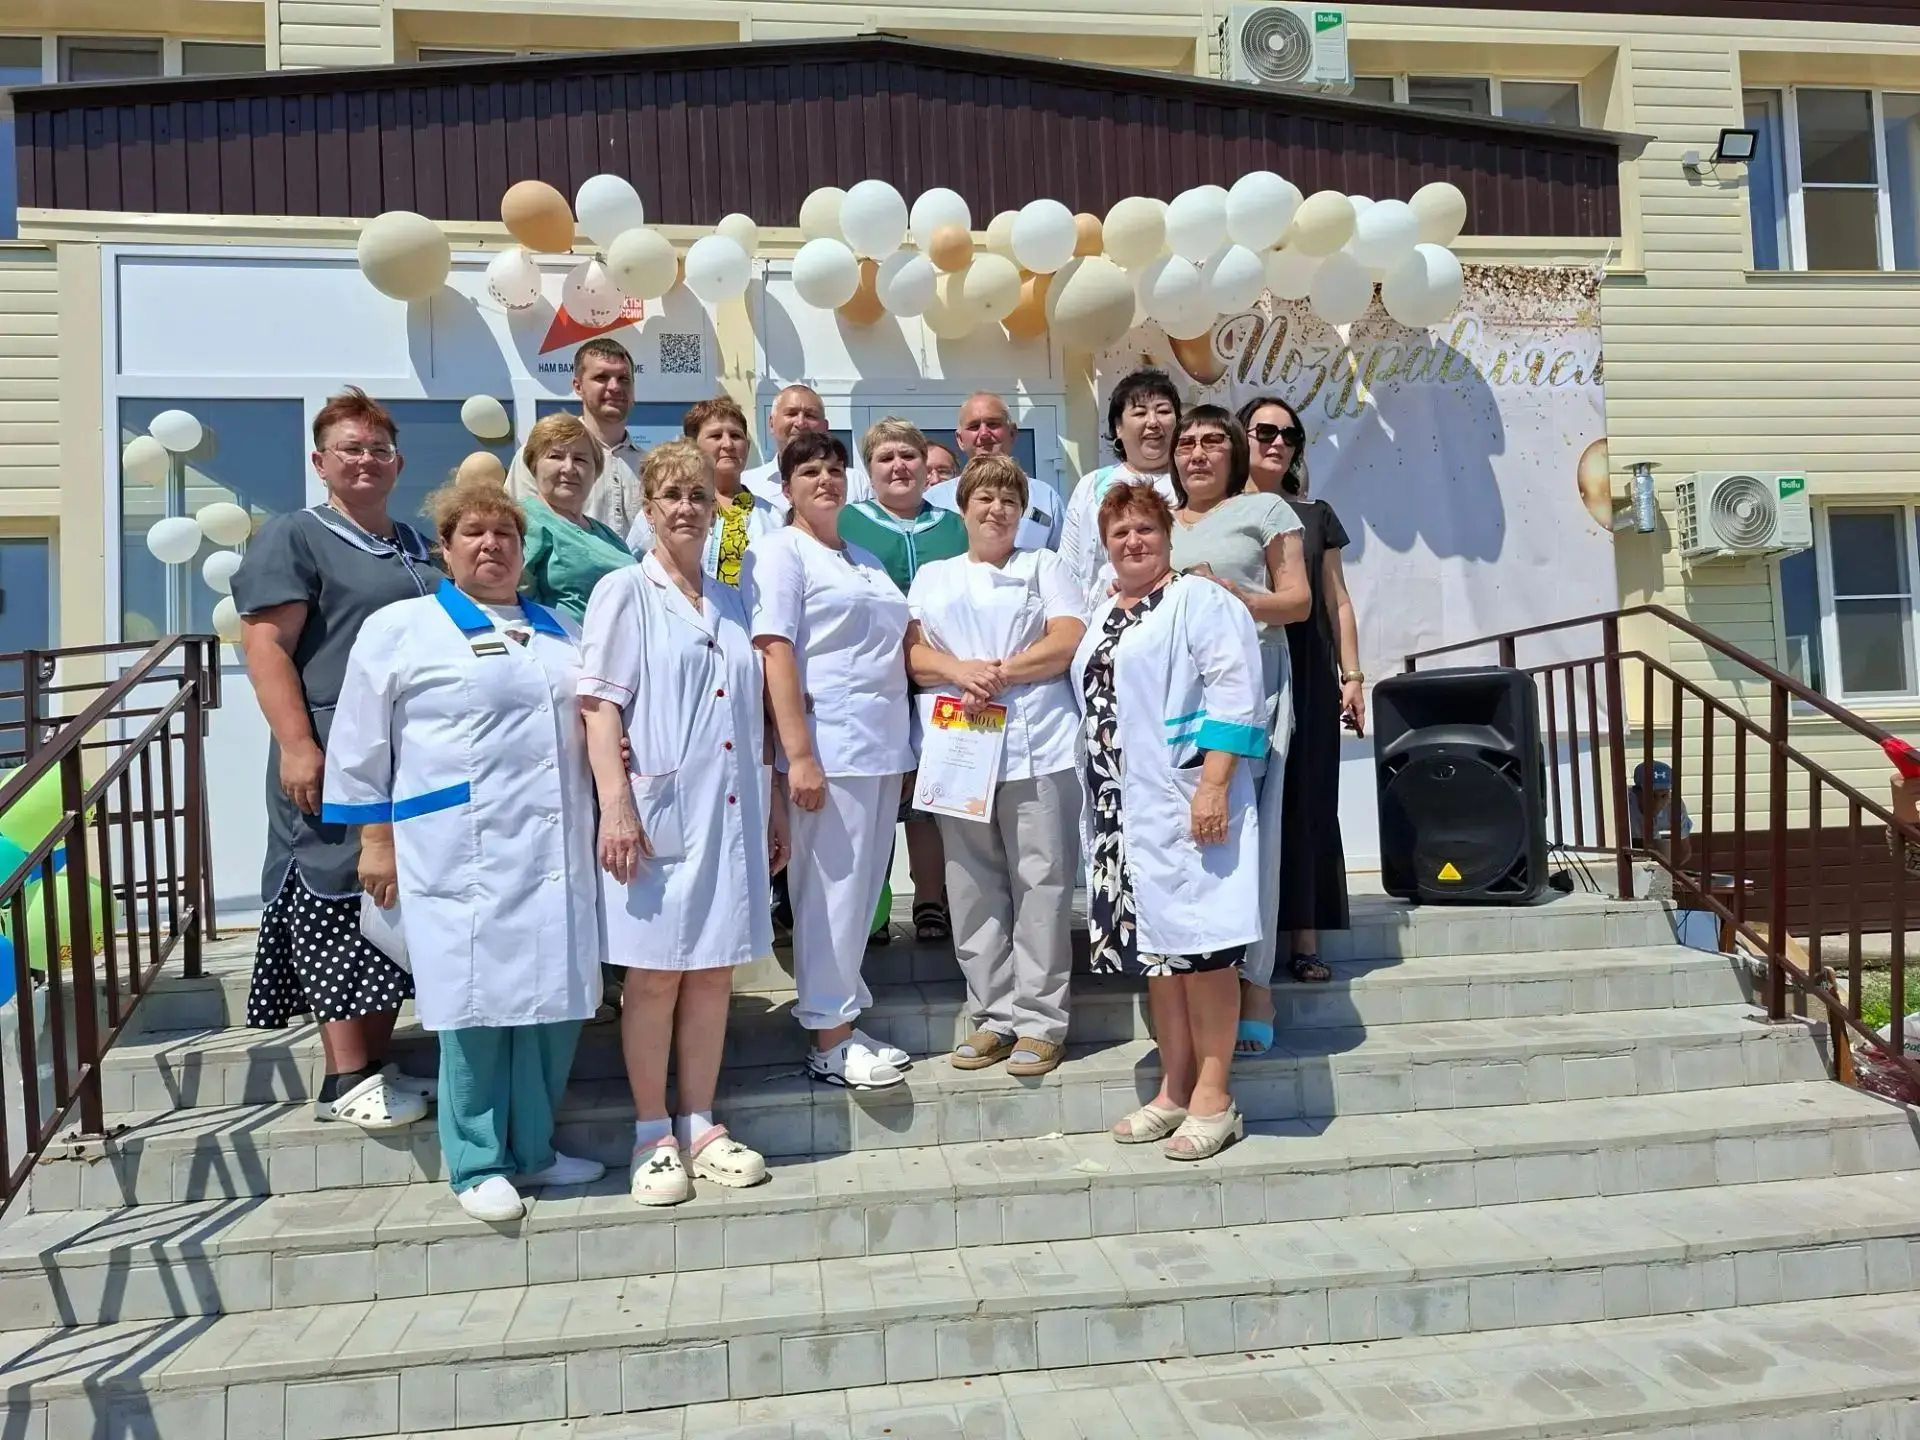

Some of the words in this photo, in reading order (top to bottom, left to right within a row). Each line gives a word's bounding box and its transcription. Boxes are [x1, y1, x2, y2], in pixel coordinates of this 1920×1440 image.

[1317, 14, 1338, 23] Ballu
[620, 308, 641, 319] ССИИ
[538, 363, 557, 373] НАМ
[558, 363, 574, 373] ВАЖ
[1781, 480, 1801, 489] Ballu
